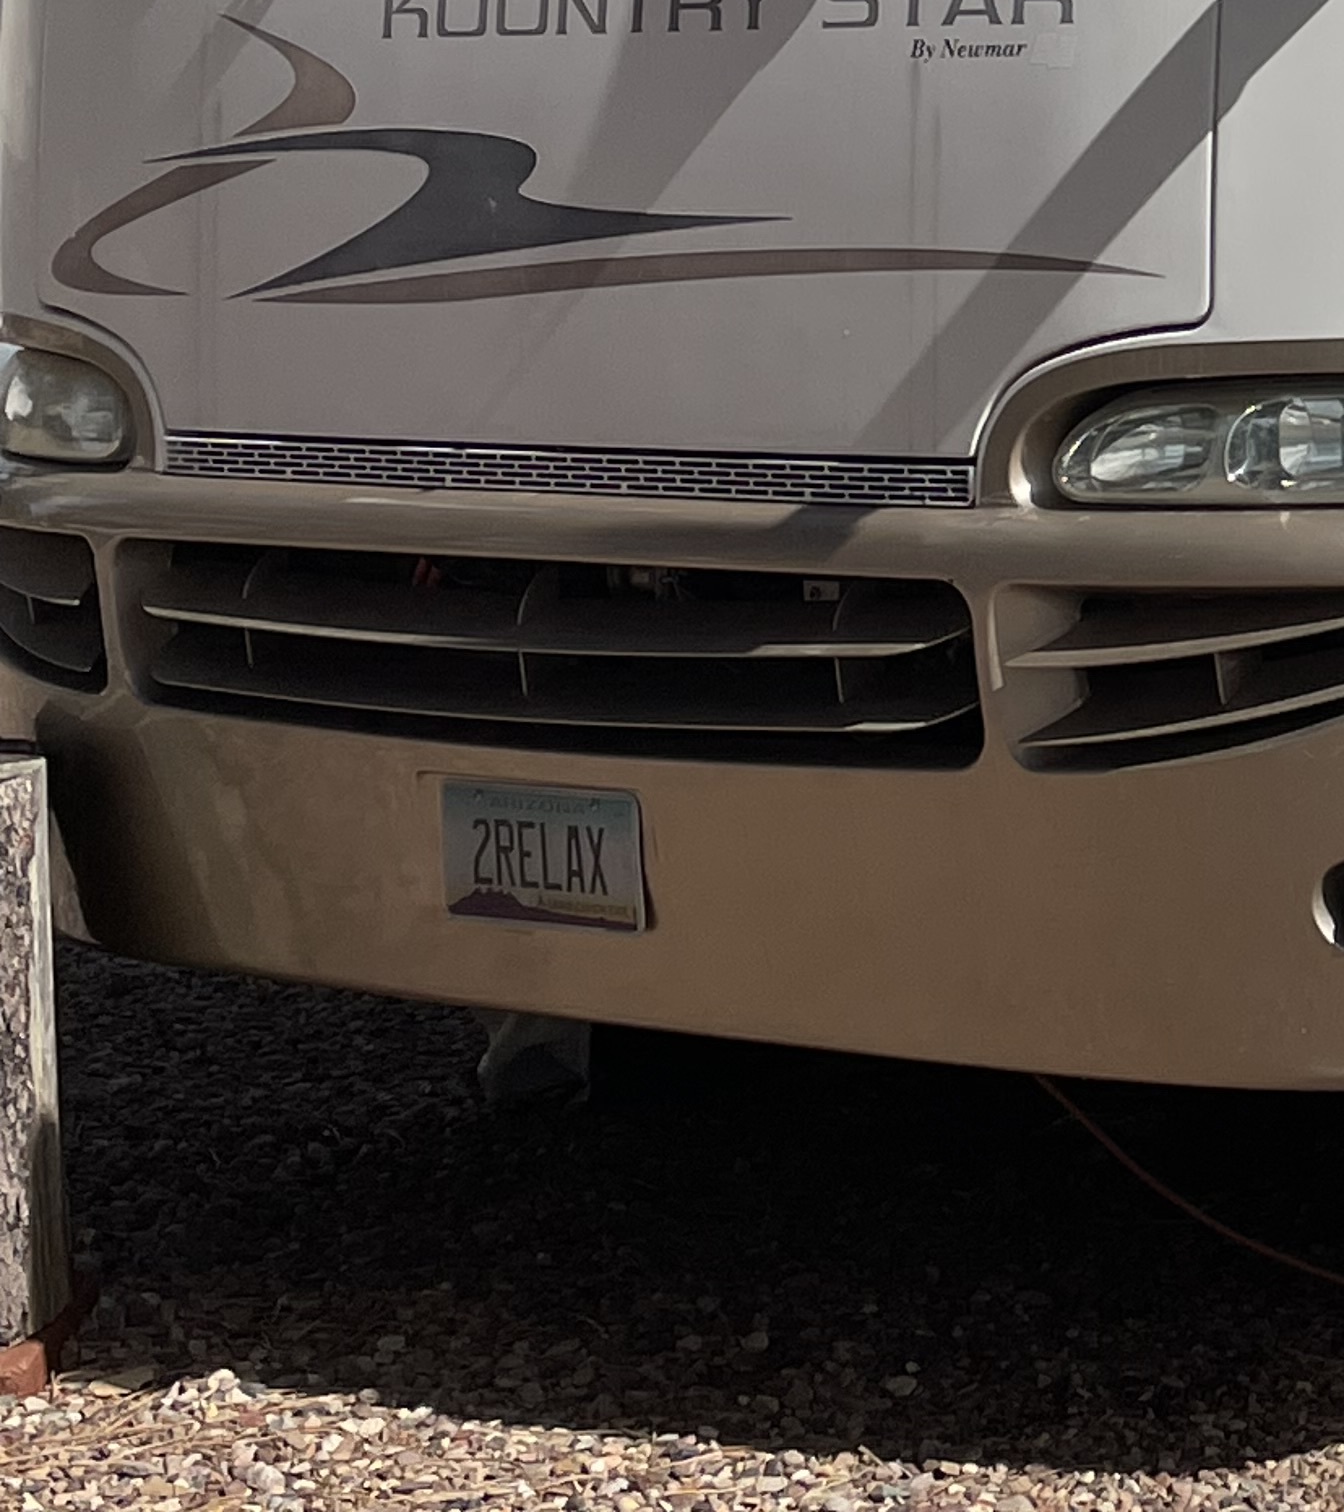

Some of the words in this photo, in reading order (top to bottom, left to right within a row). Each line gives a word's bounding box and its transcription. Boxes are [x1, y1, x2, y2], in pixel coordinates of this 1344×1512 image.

[910, 38, 936, 64] By
[940, 38, 1028, 59] Newmar
[472, 818, 609, 897] 2RELAX
